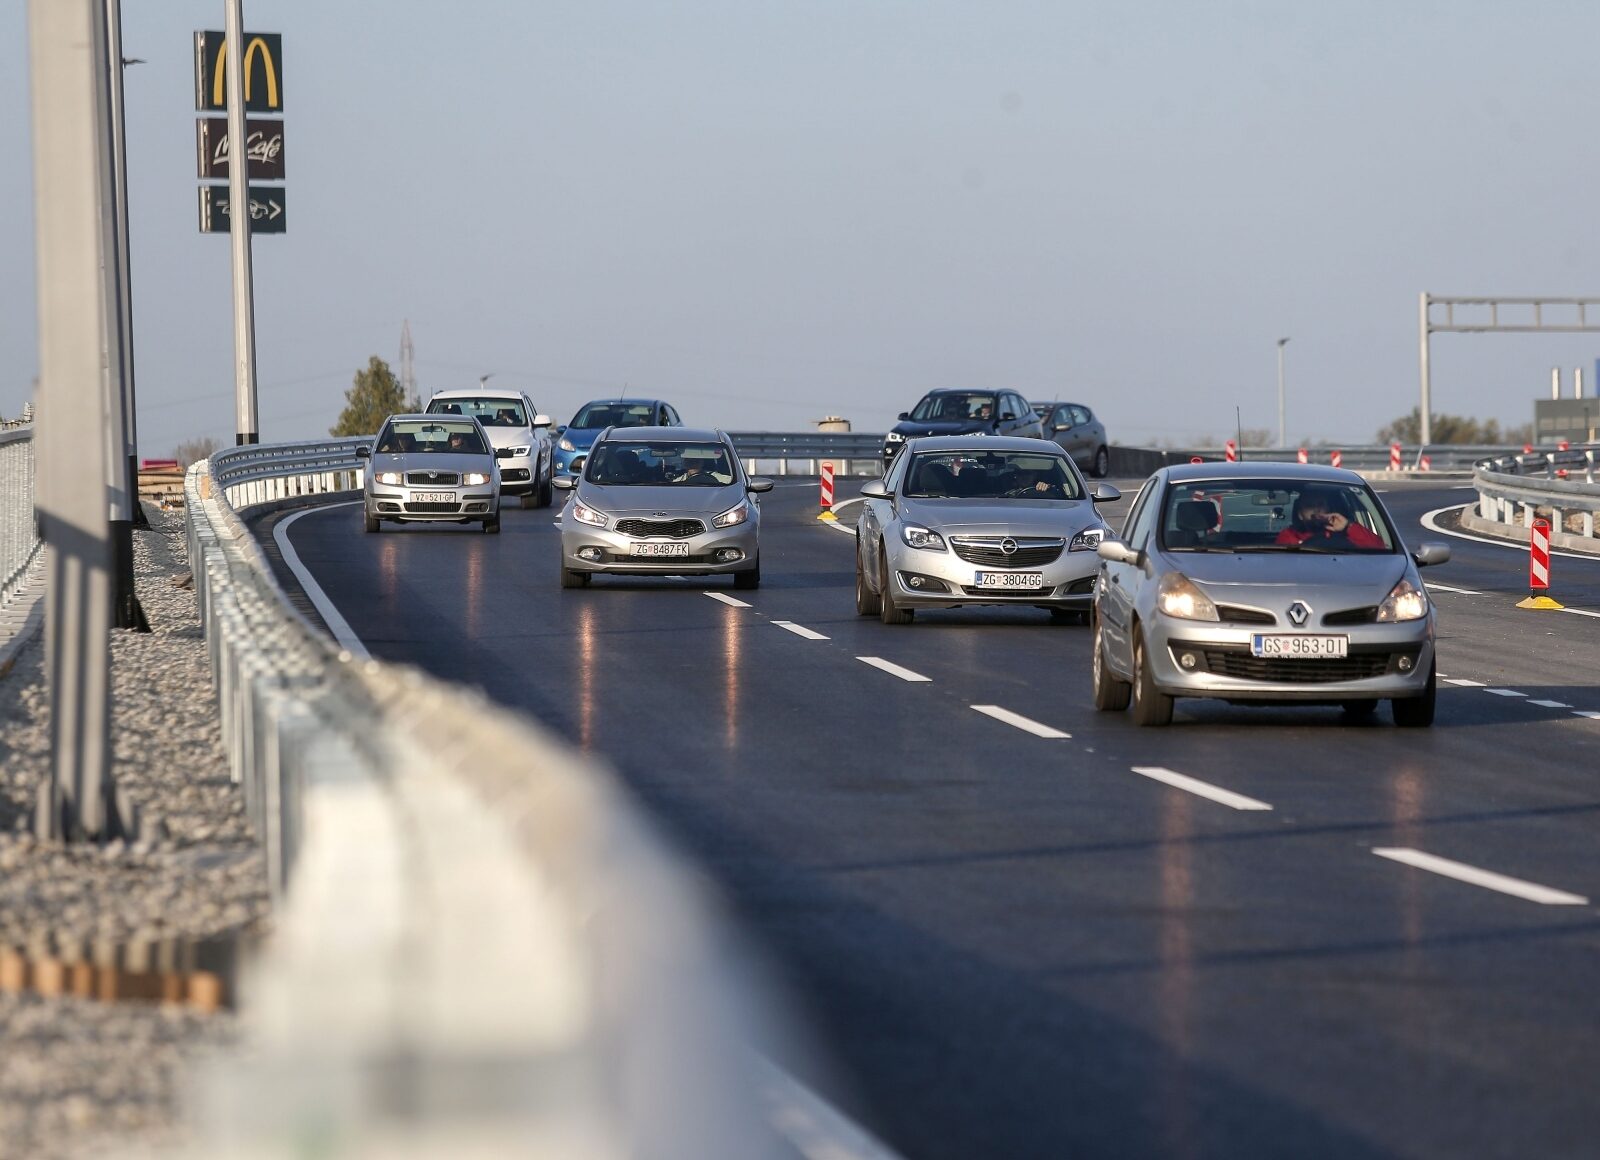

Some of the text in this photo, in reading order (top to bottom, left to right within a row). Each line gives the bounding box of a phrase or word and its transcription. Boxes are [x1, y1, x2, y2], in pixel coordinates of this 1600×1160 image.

[636, 544, 648, 554] ZG
[983, 574, 996, 585] ZG
[1264, 638, 1281, 654] GS
